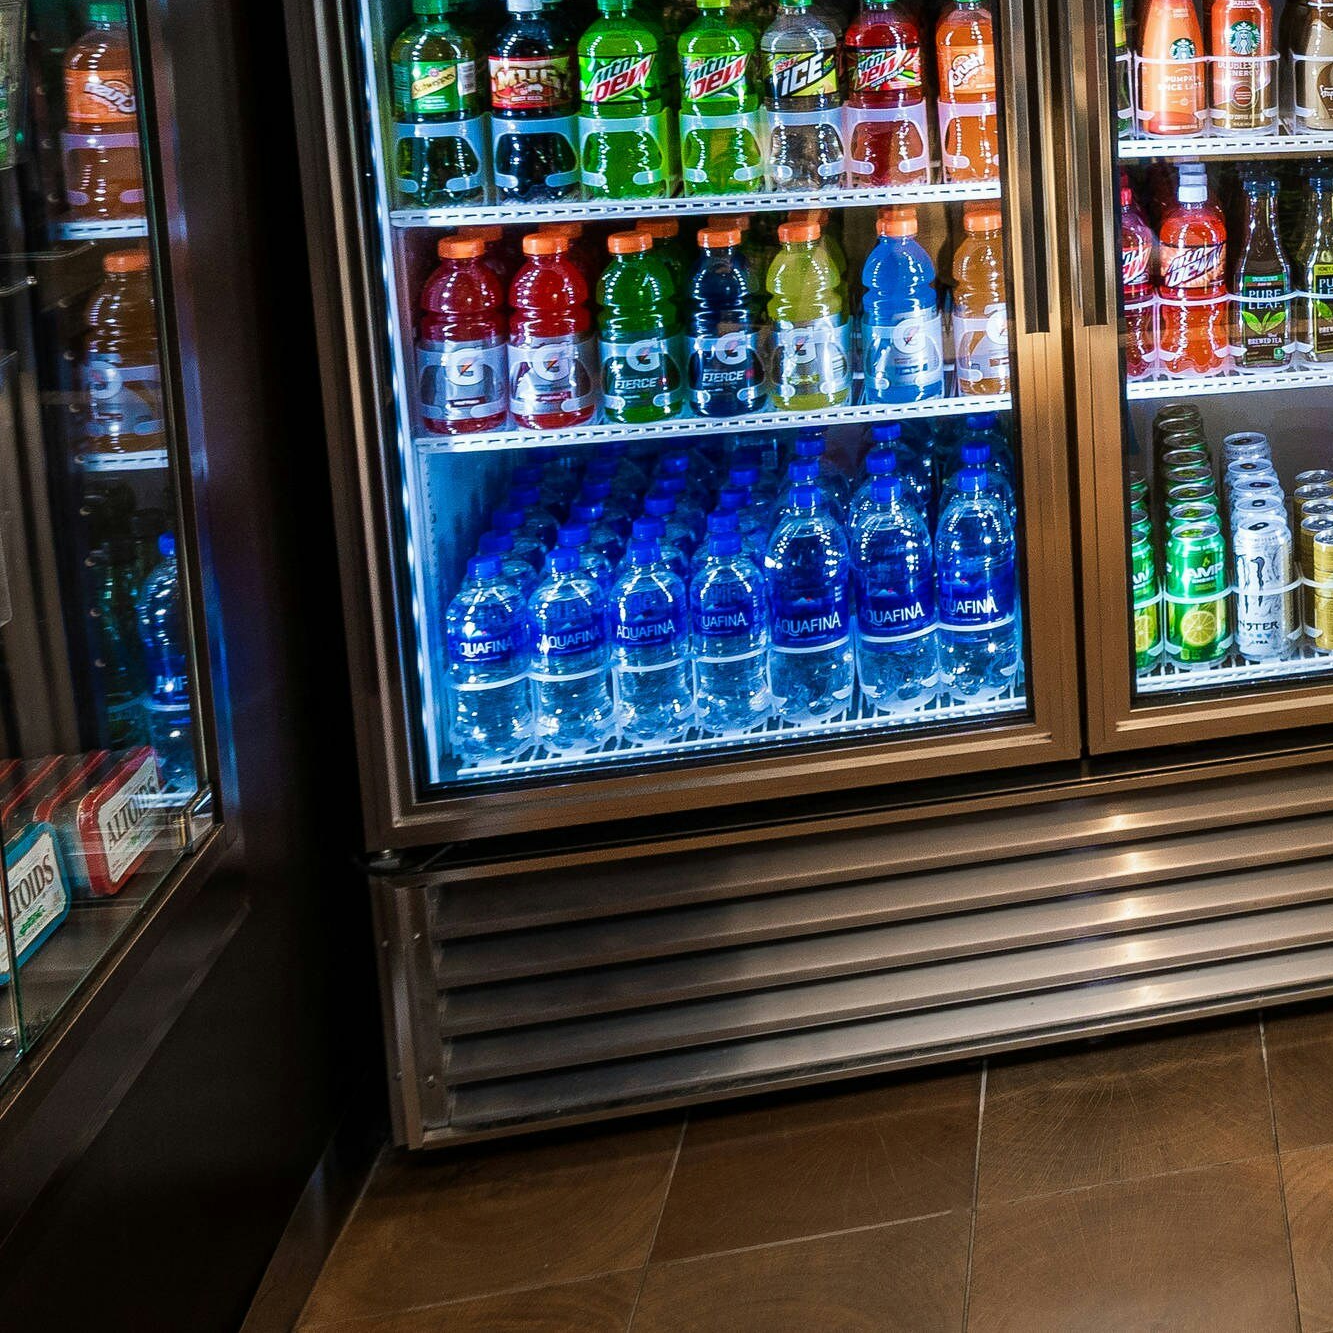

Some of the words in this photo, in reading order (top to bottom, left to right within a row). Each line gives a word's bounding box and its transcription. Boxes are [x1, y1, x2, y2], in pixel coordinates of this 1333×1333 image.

[497, 69, 562, 89] MUG
[1248, 288, 1282, 299] PURE
[614, 377, 658, 389] FIERCE
[702, 370, 745, 382] FIERCE
[1189, 562, 1224, 578] AMP
[616, 620, 675, 640] AQUAFINA
[775, 612, 841, 636] AQUAFINA
